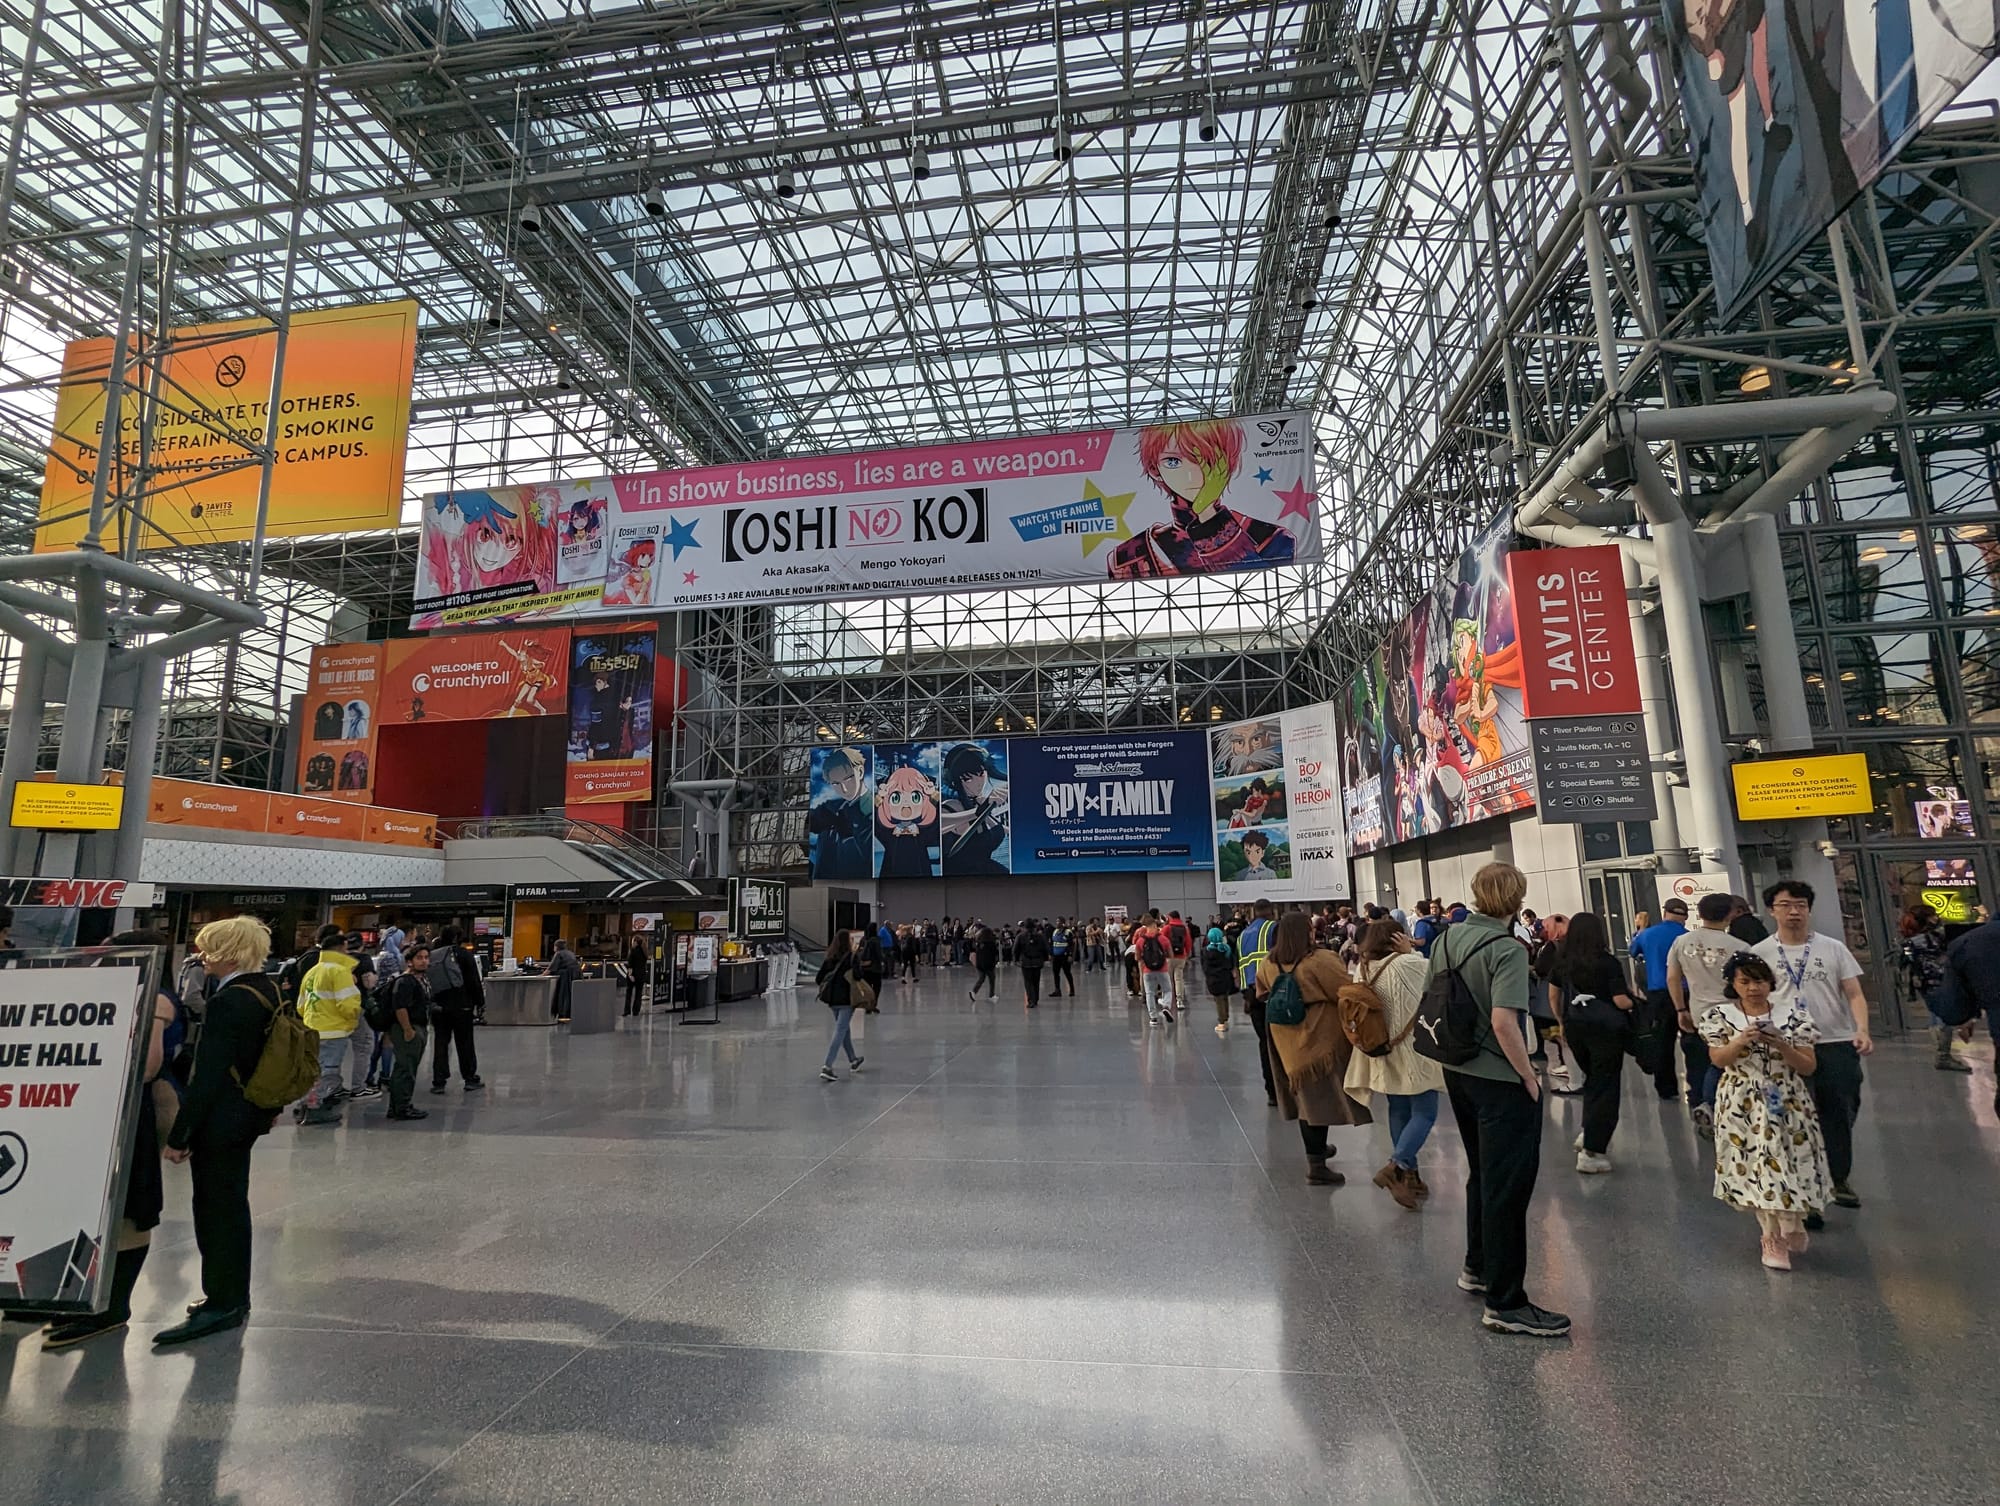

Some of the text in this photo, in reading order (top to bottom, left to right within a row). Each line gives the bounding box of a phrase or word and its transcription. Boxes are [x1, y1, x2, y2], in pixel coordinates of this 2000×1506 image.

[121, 393, 360, 432] COSIDERATE OTHERS.
[284, 416, 374, 439] SMOKING
[1283, 430, 1298, 439] Yen
[1278, 438, 1299, 447] Press
[285, 442, 368, 463] CAMPUS.
[1253, 448, 1305, 459] YenPress.com
[668, 475, 730, 502] show
[737, 466, 845, 496] business,
[854, 457, 895, 486] lies
[902, 459, 944, 481] are
[951, 459, 966, 477] a
[205, 501, 233, 511] JAVITS
[1017, 501, 1099, 527] WATCH THE ANIME
[1042, 518, 1115, 535] ON HIDIVE
[860, 554, 945, 570] Mengo Yokoyari
[762, 563, 830, 577] Aka Akasaka
[673, 568, 1042, 604] VOLUMES 1-3 ARE AVAILABLE NOW IN PRINT AND DIGITAL! VOLUME 4 RELEASES ON 11/21!
[446, 593, 471, 607] #1706
[464, 610, 477, 618] THE
[477, 605, 501, 617] MANGA
[501, 602, 519, 612] THAT
[550, 594, 562, 604] THE
[563, 592, 575, 602] HIT
[1537, 572, 1579, 691] JAVITS
[1578, 569, 1614, 689] CENTER
[331, 655, 375, 666] crunchyroll
[431, 661, 499, 674] WELCOME TO
[433, 670, 510, 689] crunchyroll
[1573, 725, 1602, 733] Pavilion
[1042, 745, 1061, 753] Carry
[1074, 744, 1090, 752] your
[1147, 740, 1174, 748] Forgers
[1555, 744, 1577, 752] Javits
[1079, 752, 1099, 760] stage
[1099, 750, 1108, 758] of
[1127, 749, 1159, 757] Schwarz!
[1294, 756, 1307, 764] THE
[1299, 761, 1322, 777] BOY
[1588, 760, 1600, 768] 2D
[1299, 776, 1313, 784] AND
[1467, 768, 1498, 790] PREMIERE
[1559, 778, 1614, 788] Special Events
[1760, 780, 1807, 789] CONSIDERATE
[595, 781, 631, 789] crunchyroll
[1823, 783, 1858, 791] SMOKING
[1294, 788, 1332, 805] HERON
[1607, 795, 1634, 804] Shuttle
[194, 800, 238, 812] crunchyroll
[306, 813, 341, 824] crunchyroll
[391, 825, 420, 833] crunchyroll
[1296, 830, 1329, 840] DECEMBER
[1300, 850, 1335, 861] IMAX
[1926, 879, 1970, 887] AVAILABLE
[330, 892, 367, 902] nuchas
[516, 888, 525, 896] DI
[525, 887, 547, 896] FARA
[233, 895, 286, 905] BEVERAGES
[30, 1002, 117, 1027] FLOOR
[36, 1042, 103, 1067] HALL
[19, 1083, 80, 1108] WAY
